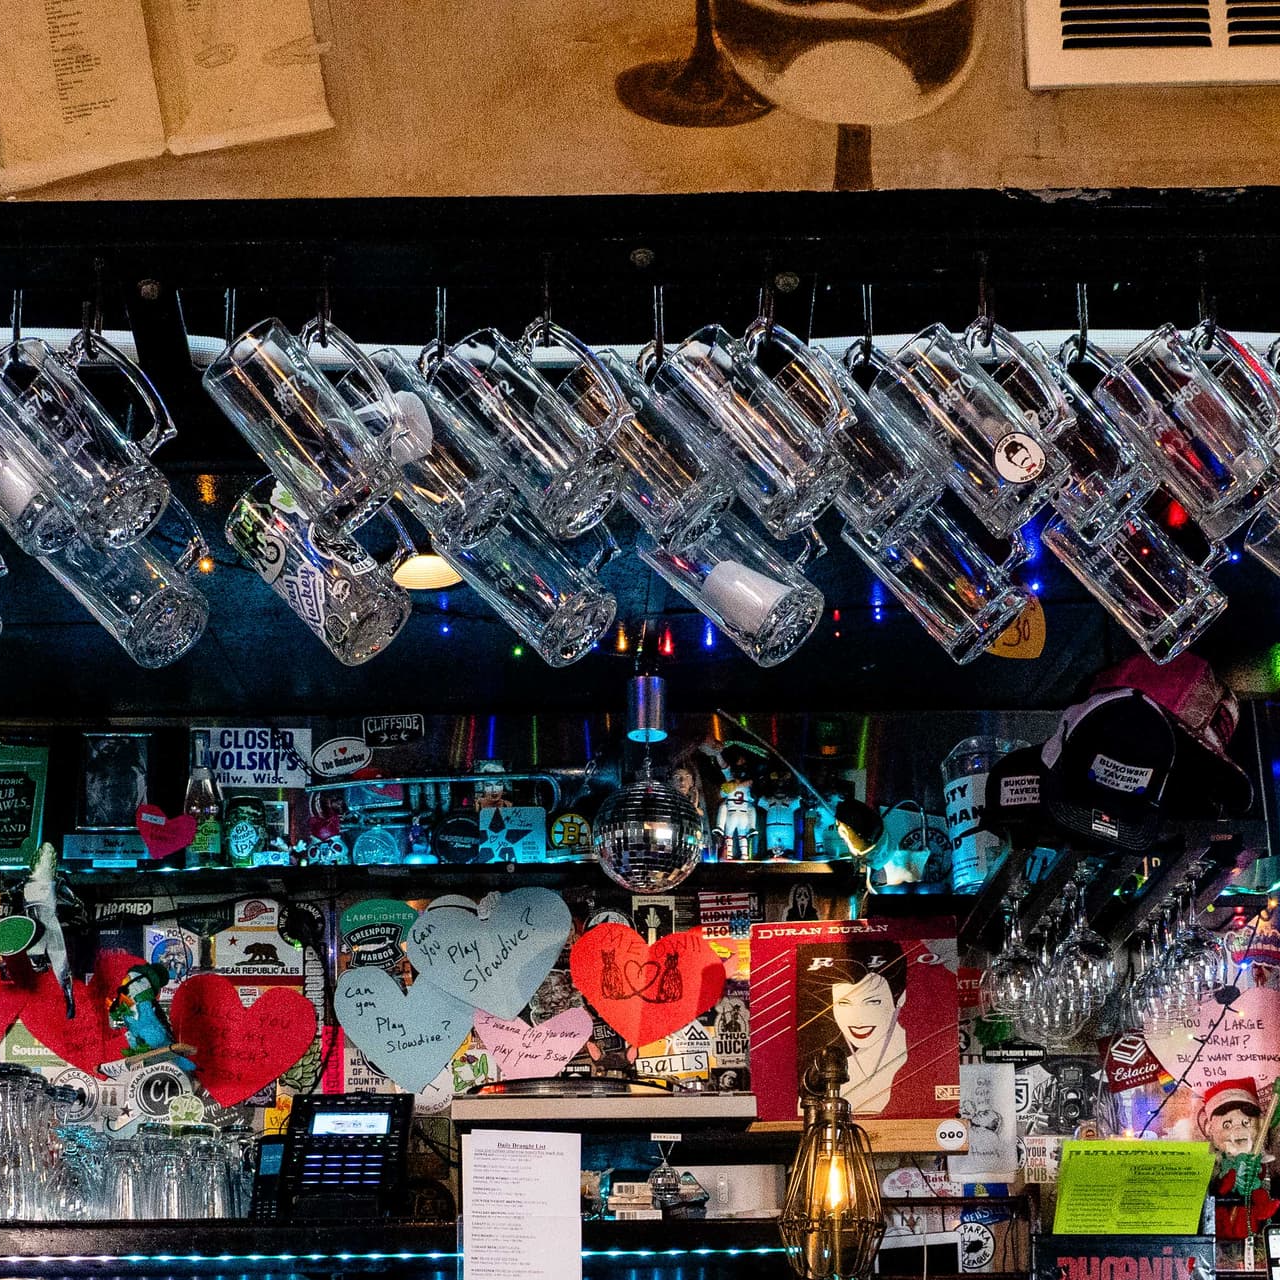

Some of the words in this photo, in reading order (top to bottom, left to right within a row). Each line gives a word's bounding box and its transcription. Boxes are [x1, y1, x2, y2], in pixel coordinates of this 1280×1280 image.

[367, 717, 419, 732] CLIFFSIDE
[1099, 758, 1149, 778] BUKOWSKI
[254, 773, 288, 785] Wisc.
[1103, 768, 1140, 784] TAVERN
[716, 895, 733, 905] ICE
[95, 903, 152, 919] THRASHED
[703, 911, 749, 923] KIDNAPS
[346, 912, 414, 923] LAMPLIGHTER
[350, 926, 397, 942] GREENPORT
[706, 926, 748, 937] PEOPLE
[758, 926, 823, 939] DURAN
[828, 924, 889, 935] DURAN
[149, 933, 164, 945] LOS
[360, 947, 395, 961] HARBOR
[448, 940, 482, 966] Play
[243, 966, 279, 975] REPUBLIC
[281, 966, 300, 975] ALES
[376, 1017, 406, 1037] Play
[1224, 1019, 1266, 1031] LARGE
[720, 1032, 747, 1040] THUG
[716, 1040, 749, 1054] DUCK
[1208, 1054, 1232, 1062] WANT
[1112, 1063, 1160, 1082] Estacio
[1204, 1067, 1227, 1077] BIG
[129, 1072, 146, 1098] CAPTAIN
[145, 1065, 183, 1078] LAWRENCE
[348, 1078, 385, 1086] COUNTRY
[1027, 1147, 1047, 1157] YOUR
[1027, 1158, 1047, 1166] LOCAL
[1026, 1169, 1047, 1181] PUB
[963, 1225, 992, 1244] PARKA
